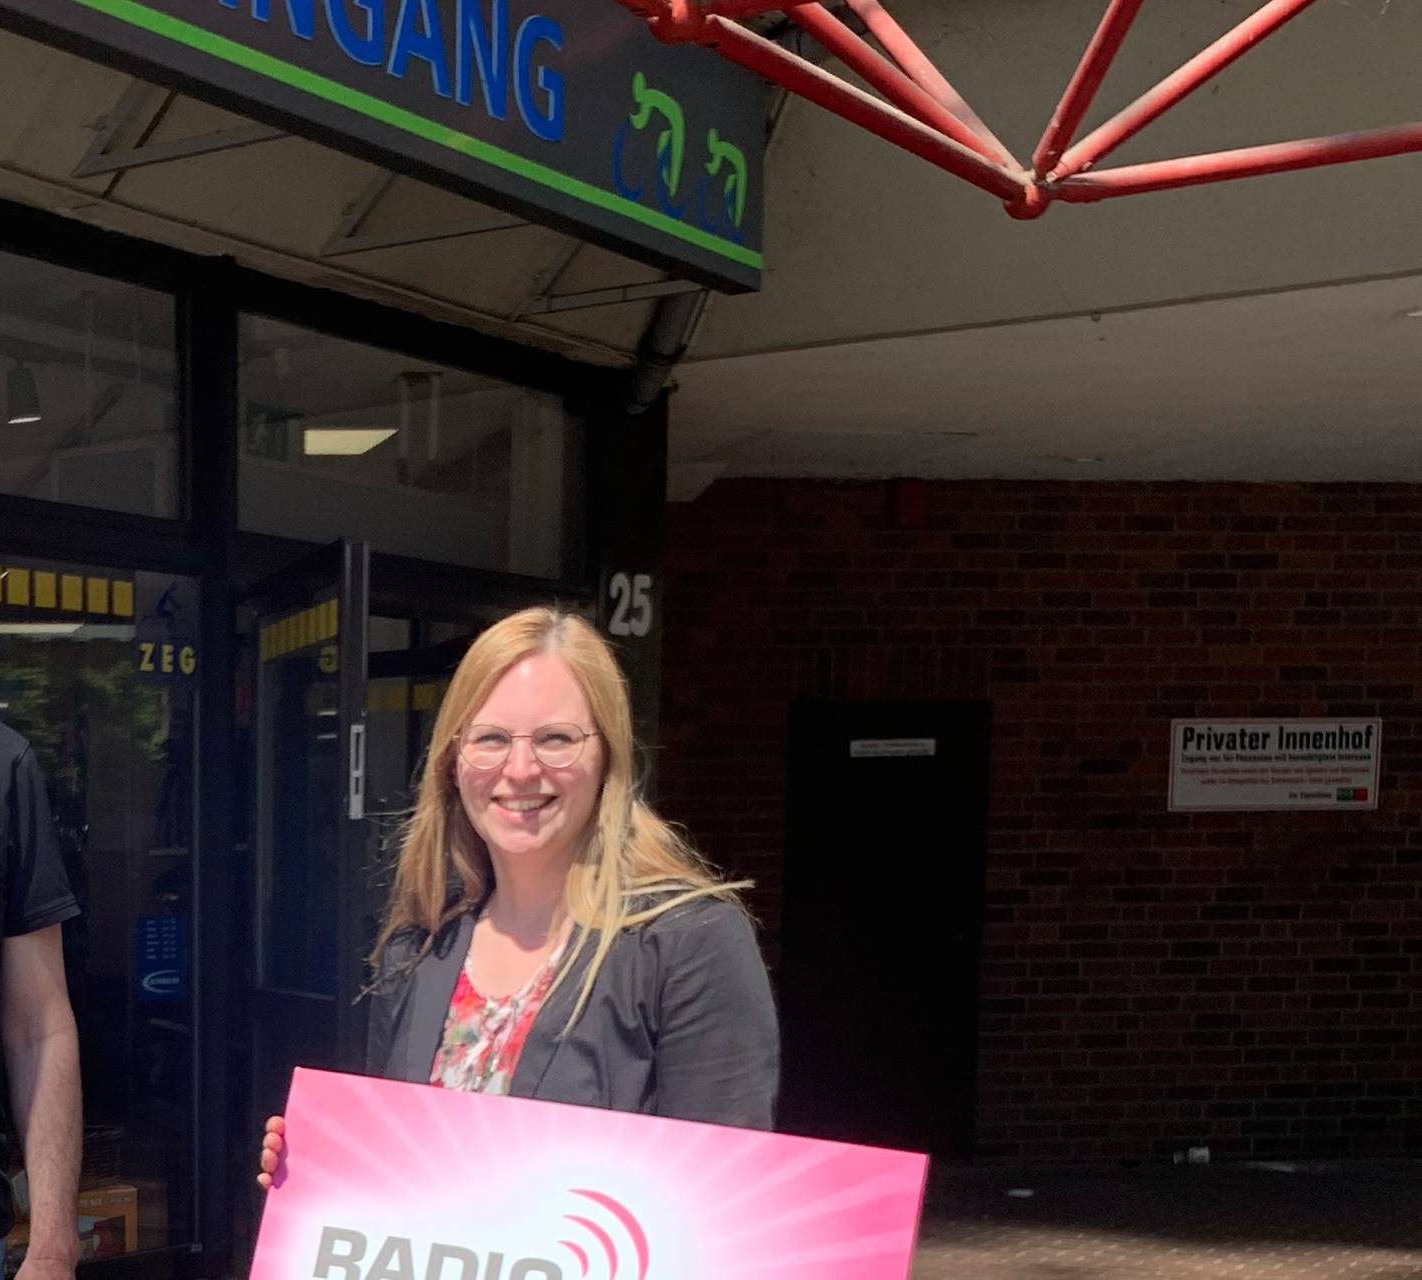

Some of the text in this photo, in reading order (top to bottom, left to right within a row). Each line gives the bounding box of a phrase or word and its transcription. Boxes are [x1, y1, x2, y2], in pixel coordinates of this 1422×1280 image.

[609, 572, 652, 637] 25
[139, 642, 196, 674] ZEG
[1182, 725, 1373, 750] Privater Innenhof
